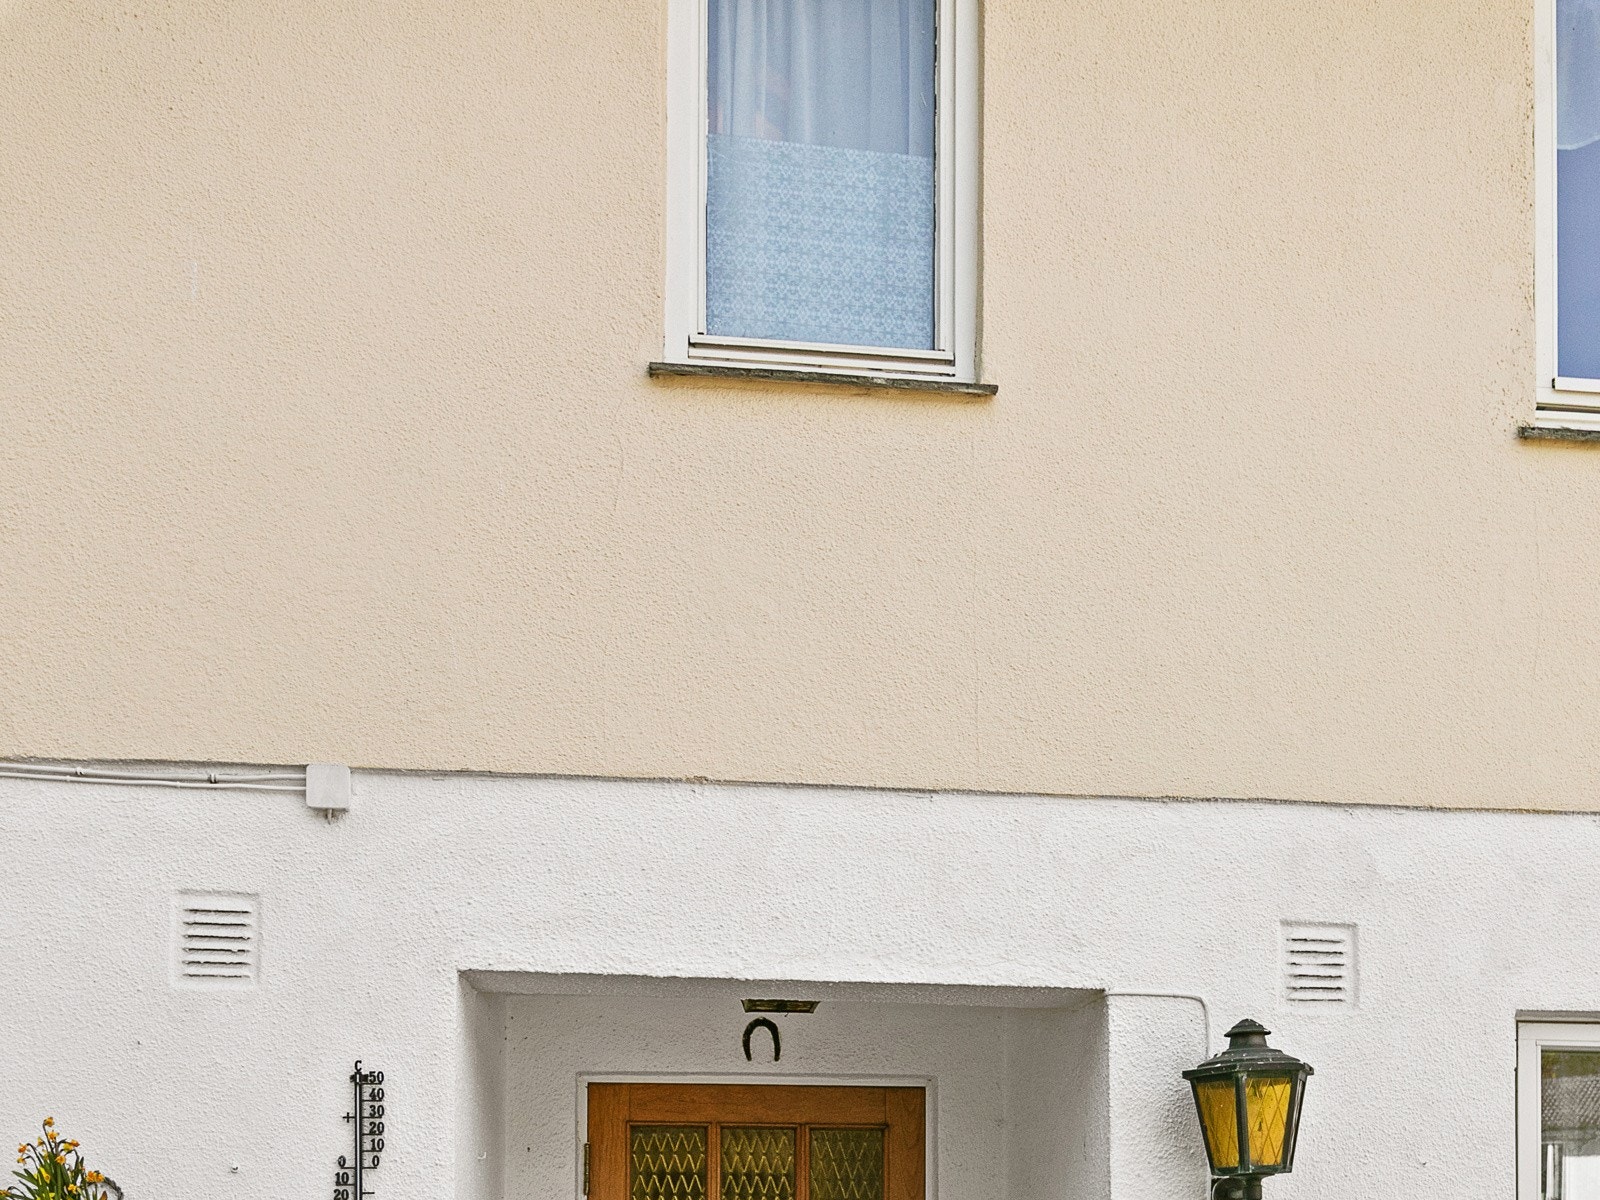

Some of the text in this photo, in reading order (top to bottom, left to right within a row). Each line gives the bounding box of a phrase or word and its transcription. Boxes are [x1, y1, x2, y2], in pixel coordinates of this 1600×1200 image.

[354, 1060, 362, 1072] C
[369, 1071, 384, 1083] 50
[369, 1088, 384, 1100] 40
[369, 1105, 384, 1117] 30
[369, 1121, 384, 1133] 20
[370, 1138, 384, 1150] 10
[338, 1155, 346, 1167] 0
[372, 1155, 380, 1167] 0
[335, 1172, 349, 1184] 10
[334, 1189, 349, 1200] 20
